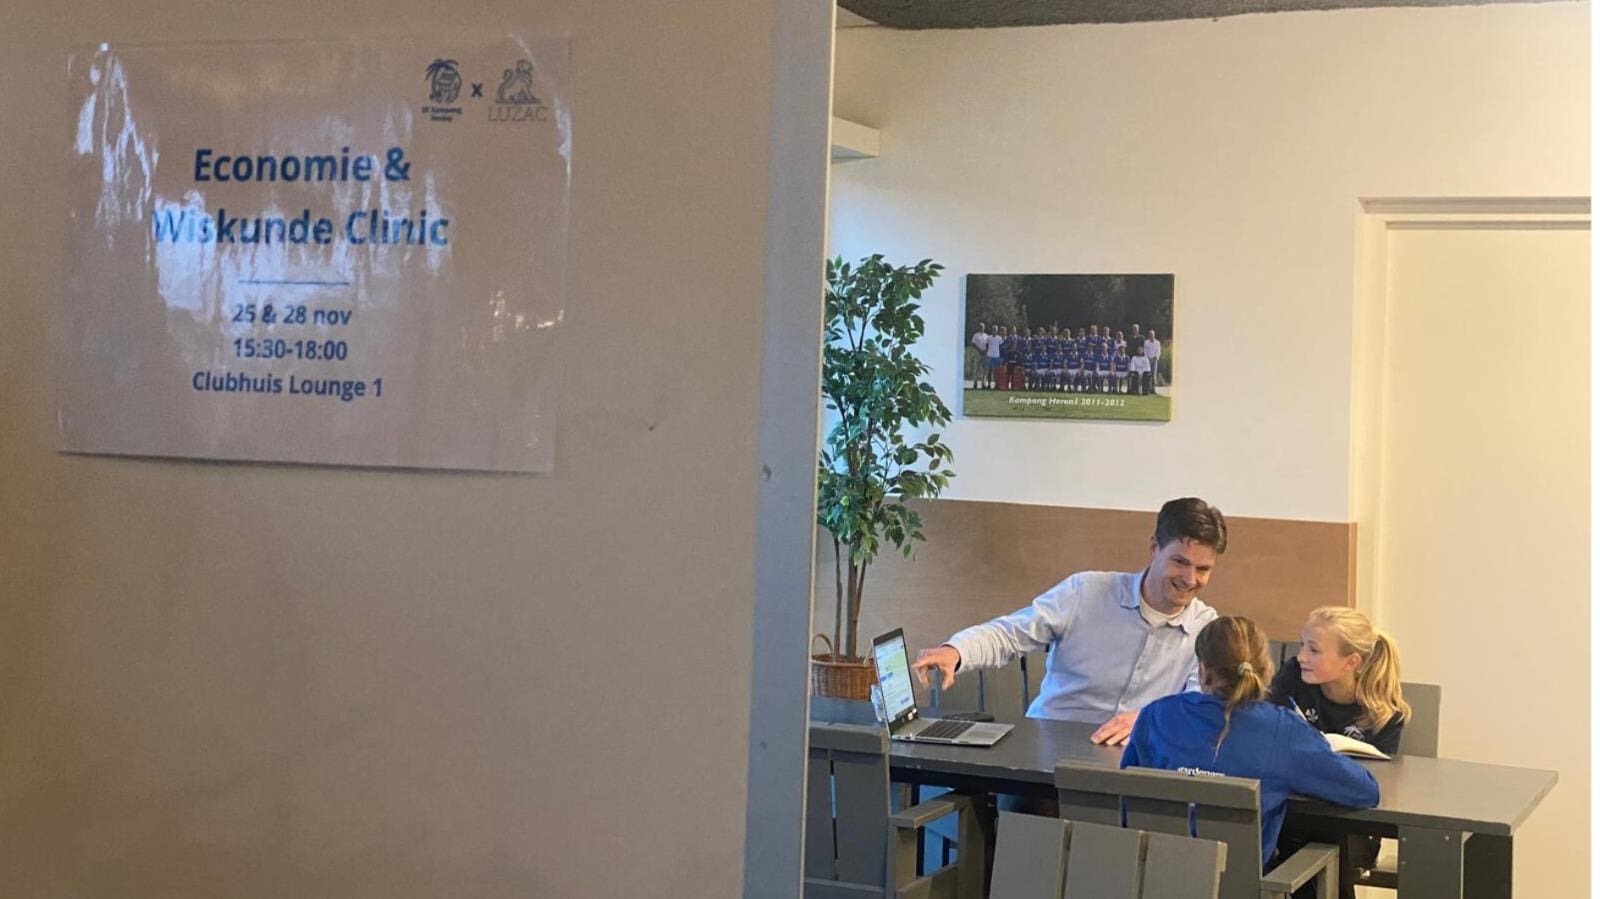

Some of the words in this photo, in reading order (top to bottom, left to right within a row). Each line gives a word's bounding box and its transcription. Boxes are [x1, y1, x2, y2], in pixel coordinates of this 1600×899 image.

[488, 106, 548, 122] LUZAC
[194, 147, 372, 182] Economie
[384, 147, 411, 181] &
[152, 208, 333, 245] Wiskunde
[346, 209, 449, 246] Clinic
[232, 304, 256, 322] 25
[262, 304, 277, 324] &
[283, 305, 307, 325] 28
[313, 309, 352, 325] nov
[233, 338, 348, 360] 15:30-18:00
[192, 371, 283, 394] Clubhuis
[289, 375, 366, 401] Lounge
[373, 378, 382, 397] 1
[1081, 397, 1125, 407] 2011-2012
